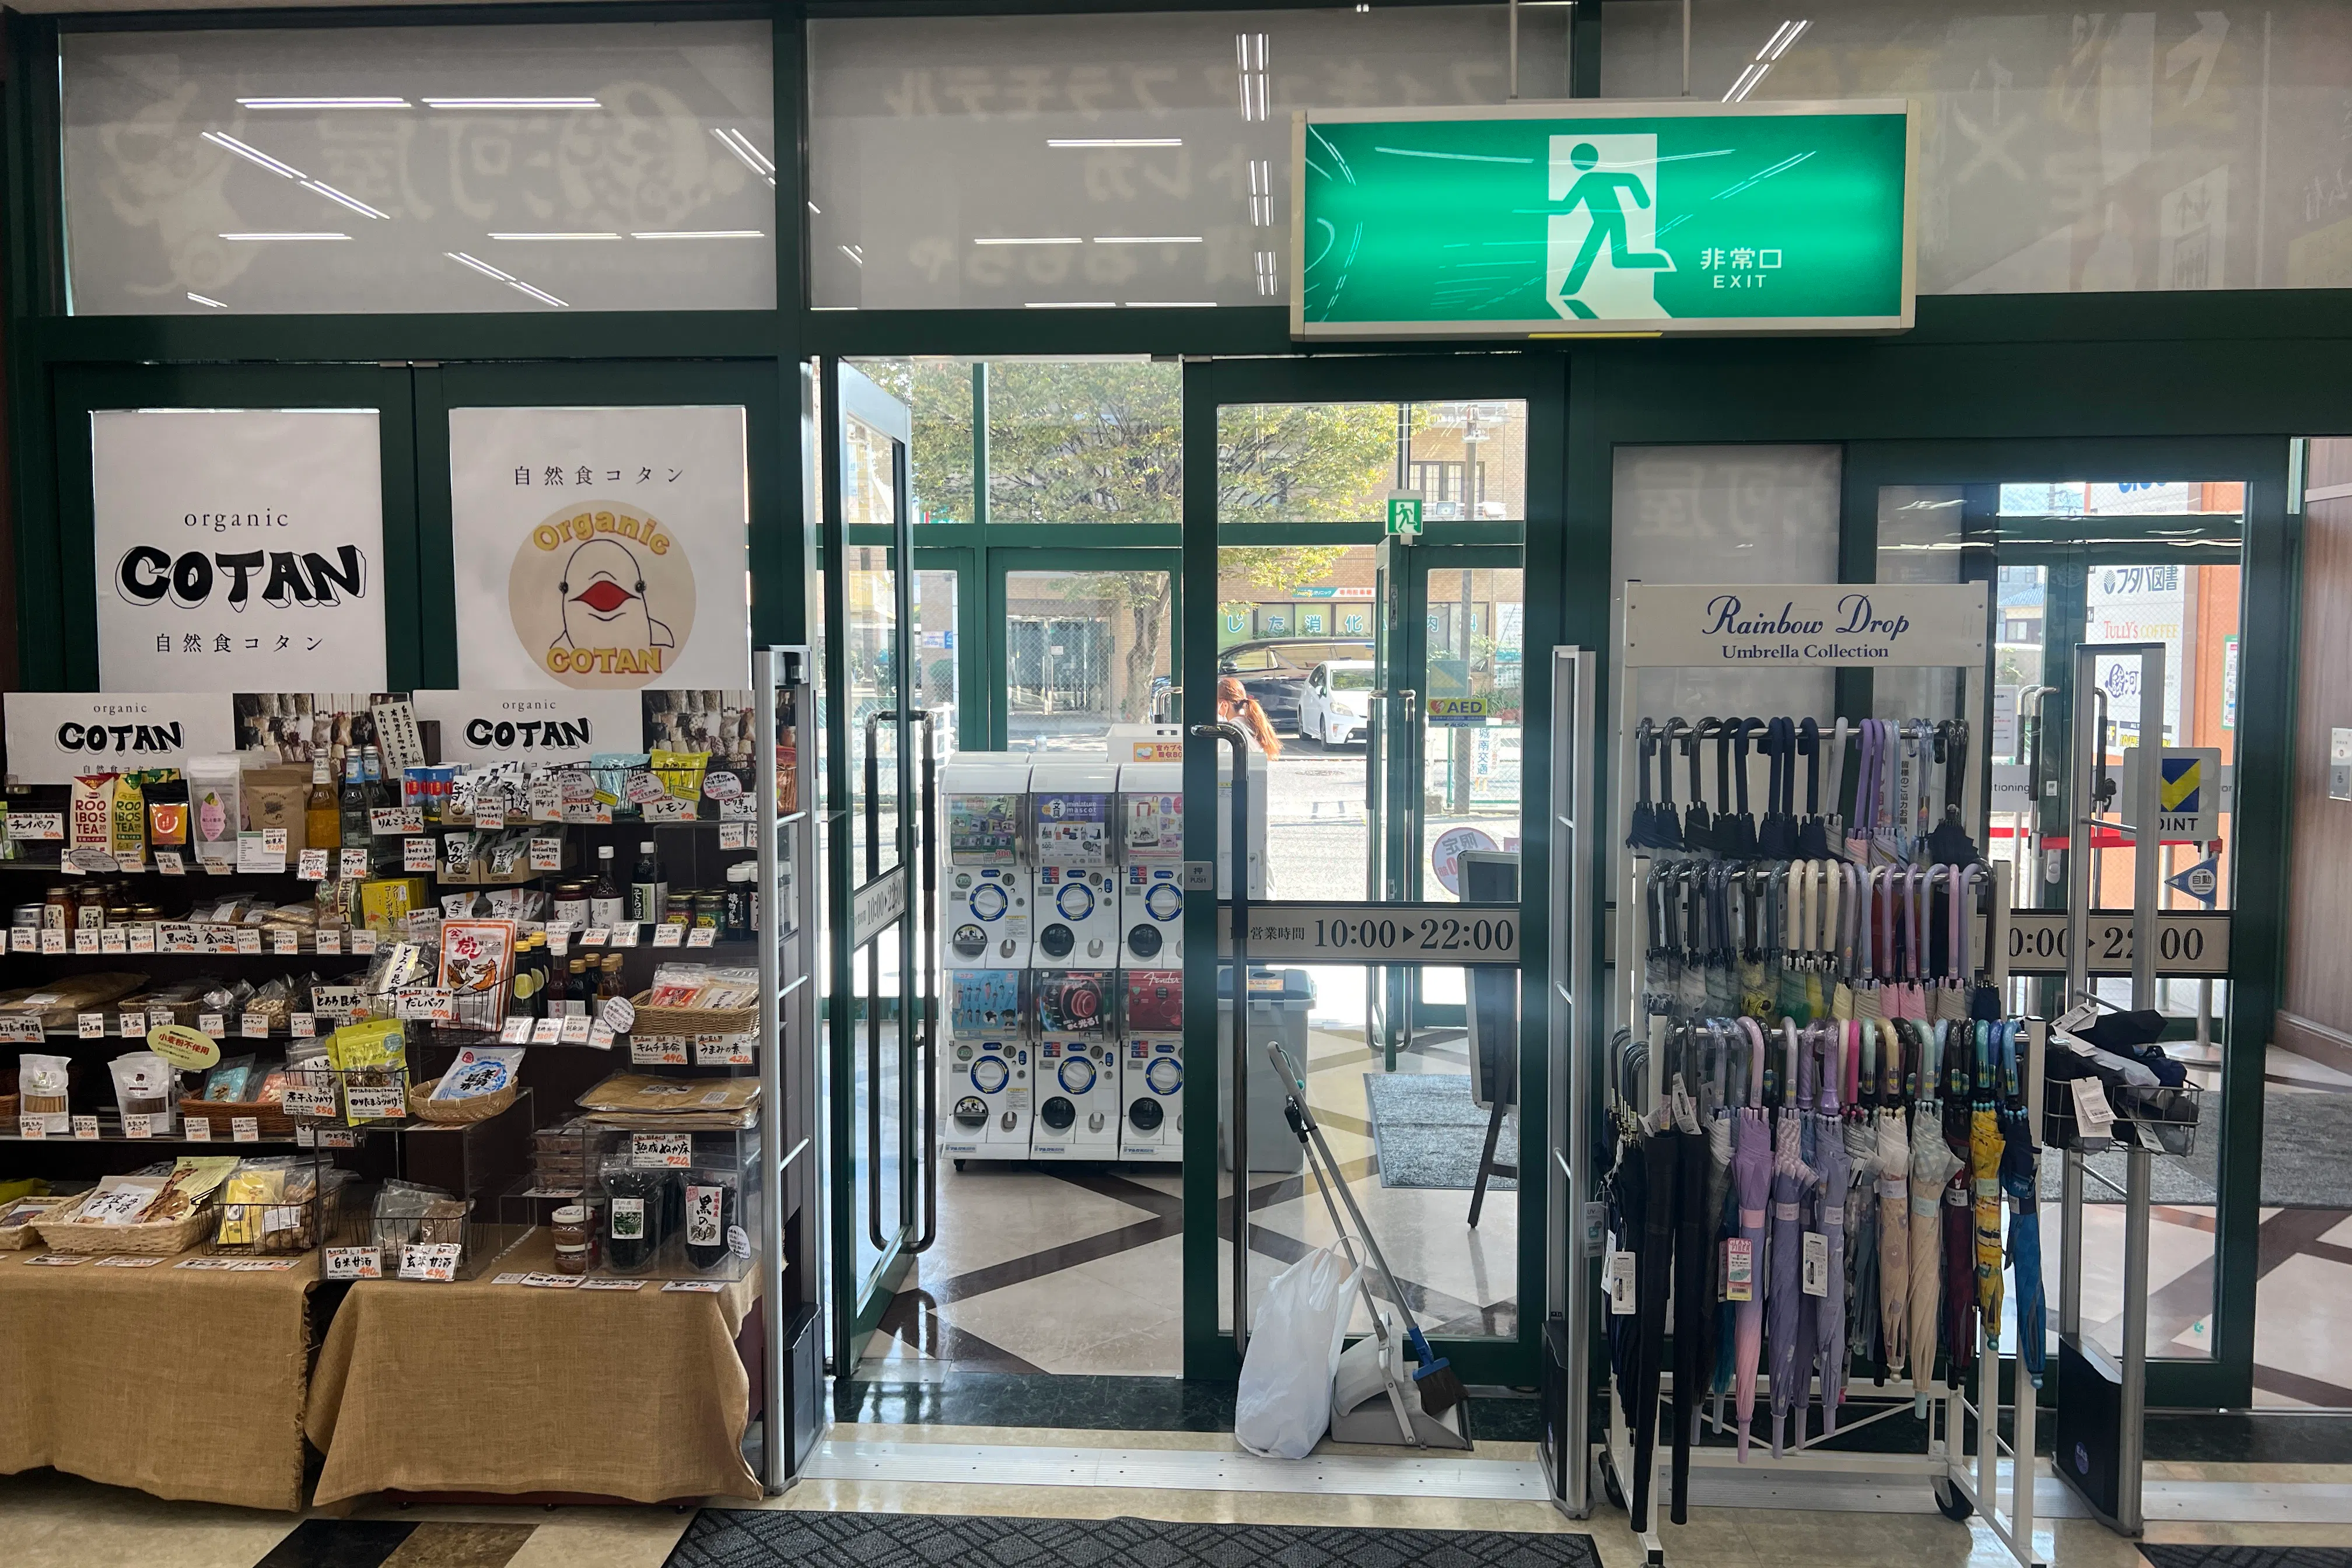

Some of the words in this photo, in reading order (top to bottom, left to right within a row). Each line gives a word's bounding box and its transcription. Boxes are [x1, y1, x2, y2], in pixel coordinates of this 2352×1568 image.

[1700, 247, 1783, 271] 非常口
[1713, 275, 1766, 289] EXIT
[514, 466, 683, 486] 自然食コタン
[184, 508, 289, 533] organic
[533, 510, 671, 556] Organic
[115, 544, 367, 613] COTAN
[2116, 565, 2179, 594] フタバ図書
[1702, 594, 1824, 636] Rainbow
[1835, 593, 1910, 641] Drop
[2140, 624, 2179, 639] COFFEE
[156, 633, 323, 653] 自然食コタン
[1721, 644, 1800, 659] Umbrella
[1804, 644, 1889, 659] Collection
[546, 647, 663, 674] COTAN
[93, 703, 147, 715] organic
[502, 699, 556, 712] organic
[1446, 701, 1483, 713] AED
[55, 721, 185, 754] COTAN
[463, 717, 593, 751] COTAN
[1991, 783, 2029, 794] tioning
[75, 800, 106, 811] ROO
[116, 800, 141, 811] ROO
[568, 803, 602, 813] かぼす
[656, 802, 687, 814] レモン
[75, 811, 107, 822] IBOS
[115, 811, 141, 822] IBOS
[76, 823, 99, 834] TEA
[116, 822, 135, 832] TEA
[2160, 818, 2199, 832] OINT
[1192, 867, 1204, 876] 押
[2192, 875, 2211, 885] 自動
[633, 888, 643, 920] そら豆
[867, 894, 885, 926] 10:00
[1250, 926, 1305, 942] 営業時間
[1314, 918, 1396, 949] 10:00
[1420, 918, 1514, 950] 22:00
[454, 936, 483, 960] だし
[1143, 971, 1181, 986] Fender
[316, 995, 361, 1008] とろろ昆布
[405, 998, 445, 1010] だしパック
[430, 1009, 450, 1019] 570円
[158, 1034, 210, 1055] 小麦粉不使用
[636, 1042, 681, 1053] キムチ革命
[699, 1042, 743, 1055] うまみの素
[663, 1054, 686, 1063] 490円
[729, 1055, 752, 1064] 420円
[634, 1140, 691, 1156] 熟成ぬか床
[666, 1155, 690, 1167] 720円
[696, 1194, 712, 1242] 黒のり
[334, 1256, 372, 1269] 白米甘酒
[406, 1255, 453, 1268] 玄米甘酒
[358, 1266, 379, 1276] 490円
[425, 1268, 449, 1279] 490円
